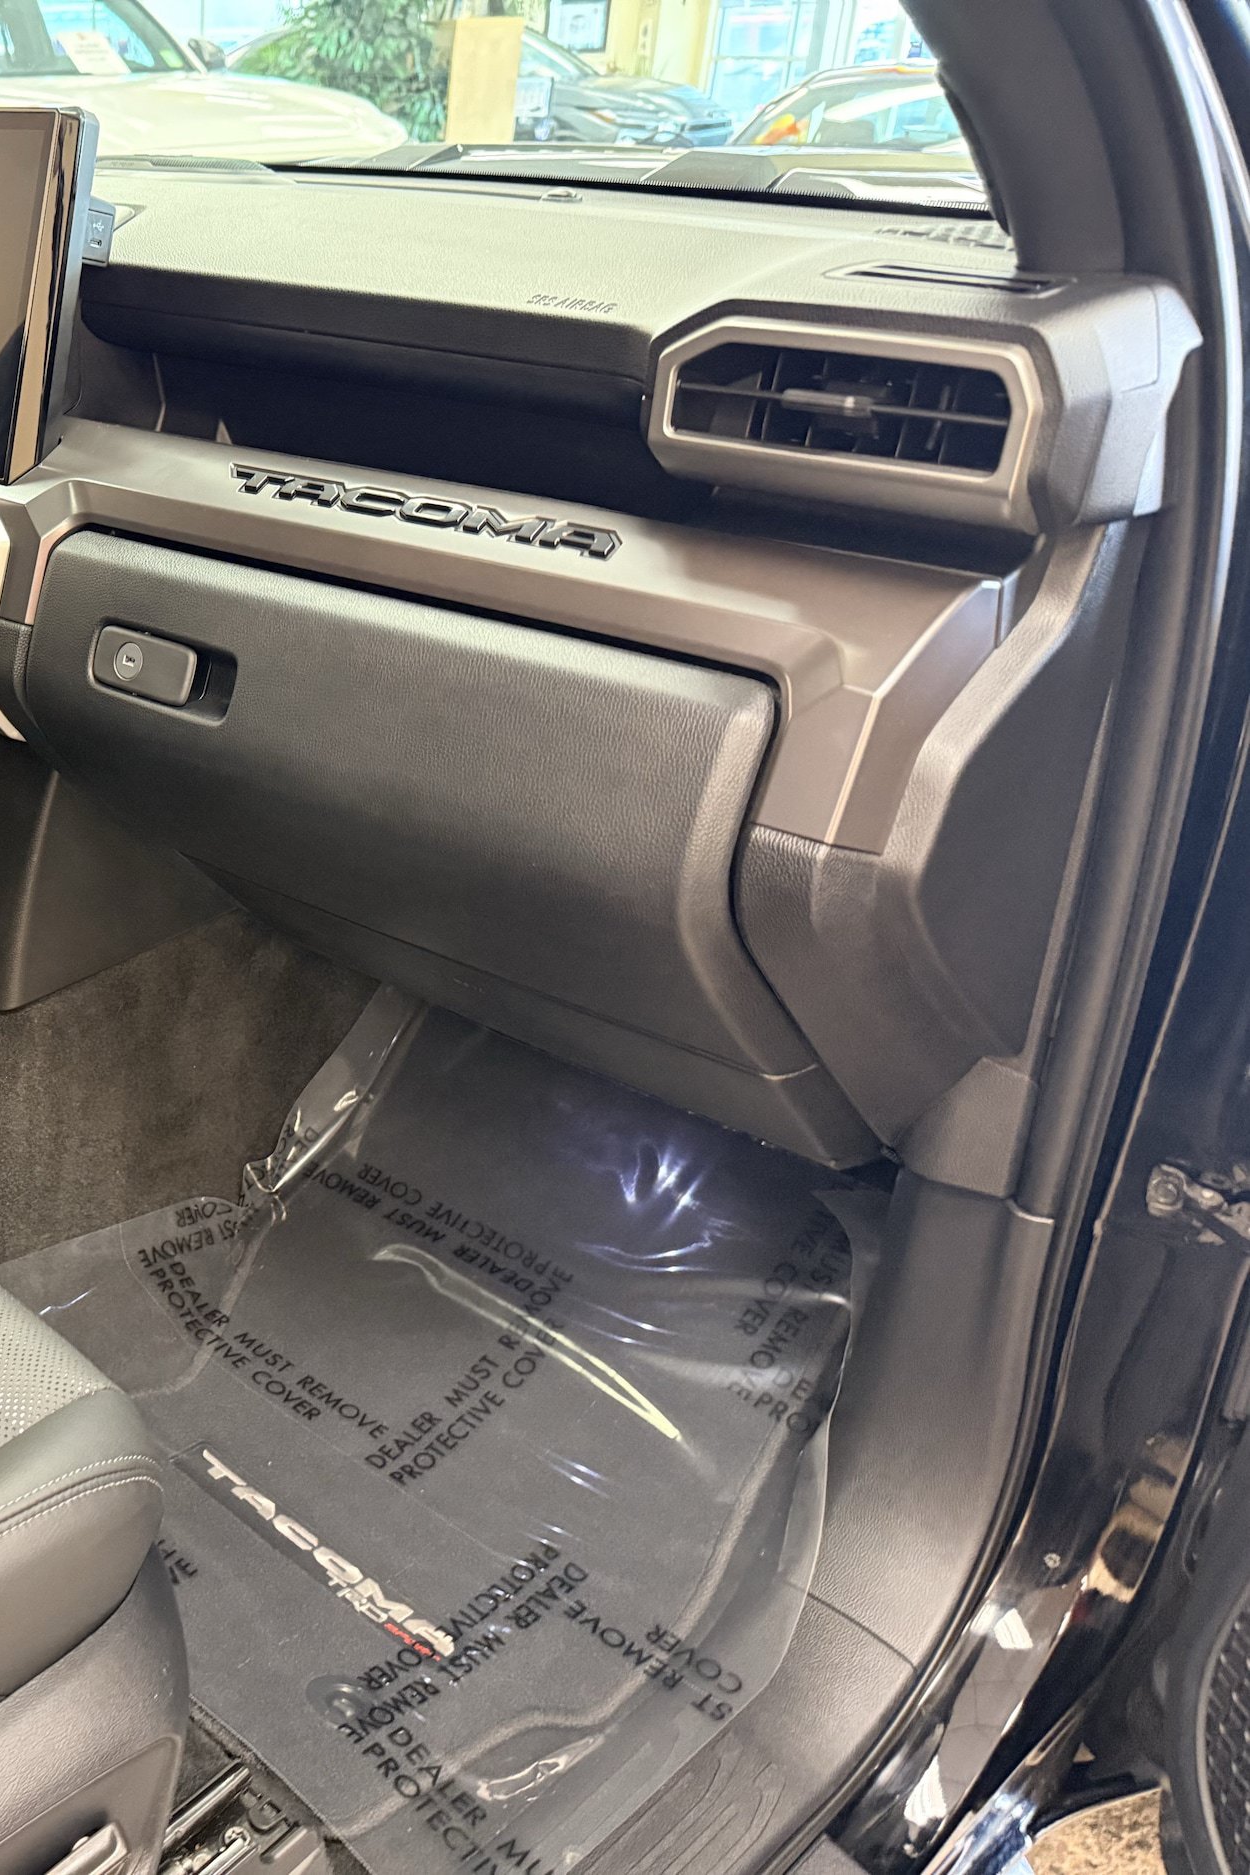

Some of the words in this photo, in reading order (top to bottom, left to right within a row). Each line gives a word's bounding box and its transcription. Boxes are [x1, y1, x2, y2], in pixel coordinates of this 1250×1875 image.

[527, 294, 557, 306] SRS
[554, 298, 617, 313] AIRBAG
[231, 463, 621, 559] TACOMA
[175, 1201, 232, 1228] COVER
[303, 1161, 382, 1210] REMOVE
[356, 1163, 423, 1206] COVER
[138, 1228, 215, 1268] REMOVE
[383, 1208, 447, 1243] MUST
[426, 1201, 552, 1276] PROTECTIVE
[453, 1245, 534, 1294] DEALER
[734, 1262, 798, 1335] COVER
[149, 1266, 251, 1369] PROTECTIVE
[252, 1370, 321, 1421] COVER
[169, 1262, 230, 1327] DEALER
[234, 1331, 294, 1373] MUST
[296, 1374, 390, 1439] REMOVE
[365, 1411, 442, 1469] DEALER
[444, 1355, 500, 1408] MUST
[389, 1391, 506, 1486] PROTECTIVE
[502, 1318, 565, 1388] COVER
[202, 1449, 455, 1657] TACOMA
[326, 1570, 389, 1624] TRD
[434, 1542, 561, 1642] PROTECTIVE
[506, 1561, 589, 1629] DEALER
[356, 1640, 438, 1691] COVER
[438, 1631, 507, 1684] MUST
[564, 1600, 684, 1691] REMOVE
[646, 1624, 743, 1694] COVER
[338, 1678, 441, 1744] REMOVE
[388, 1726, 487, 1827] DEALER
